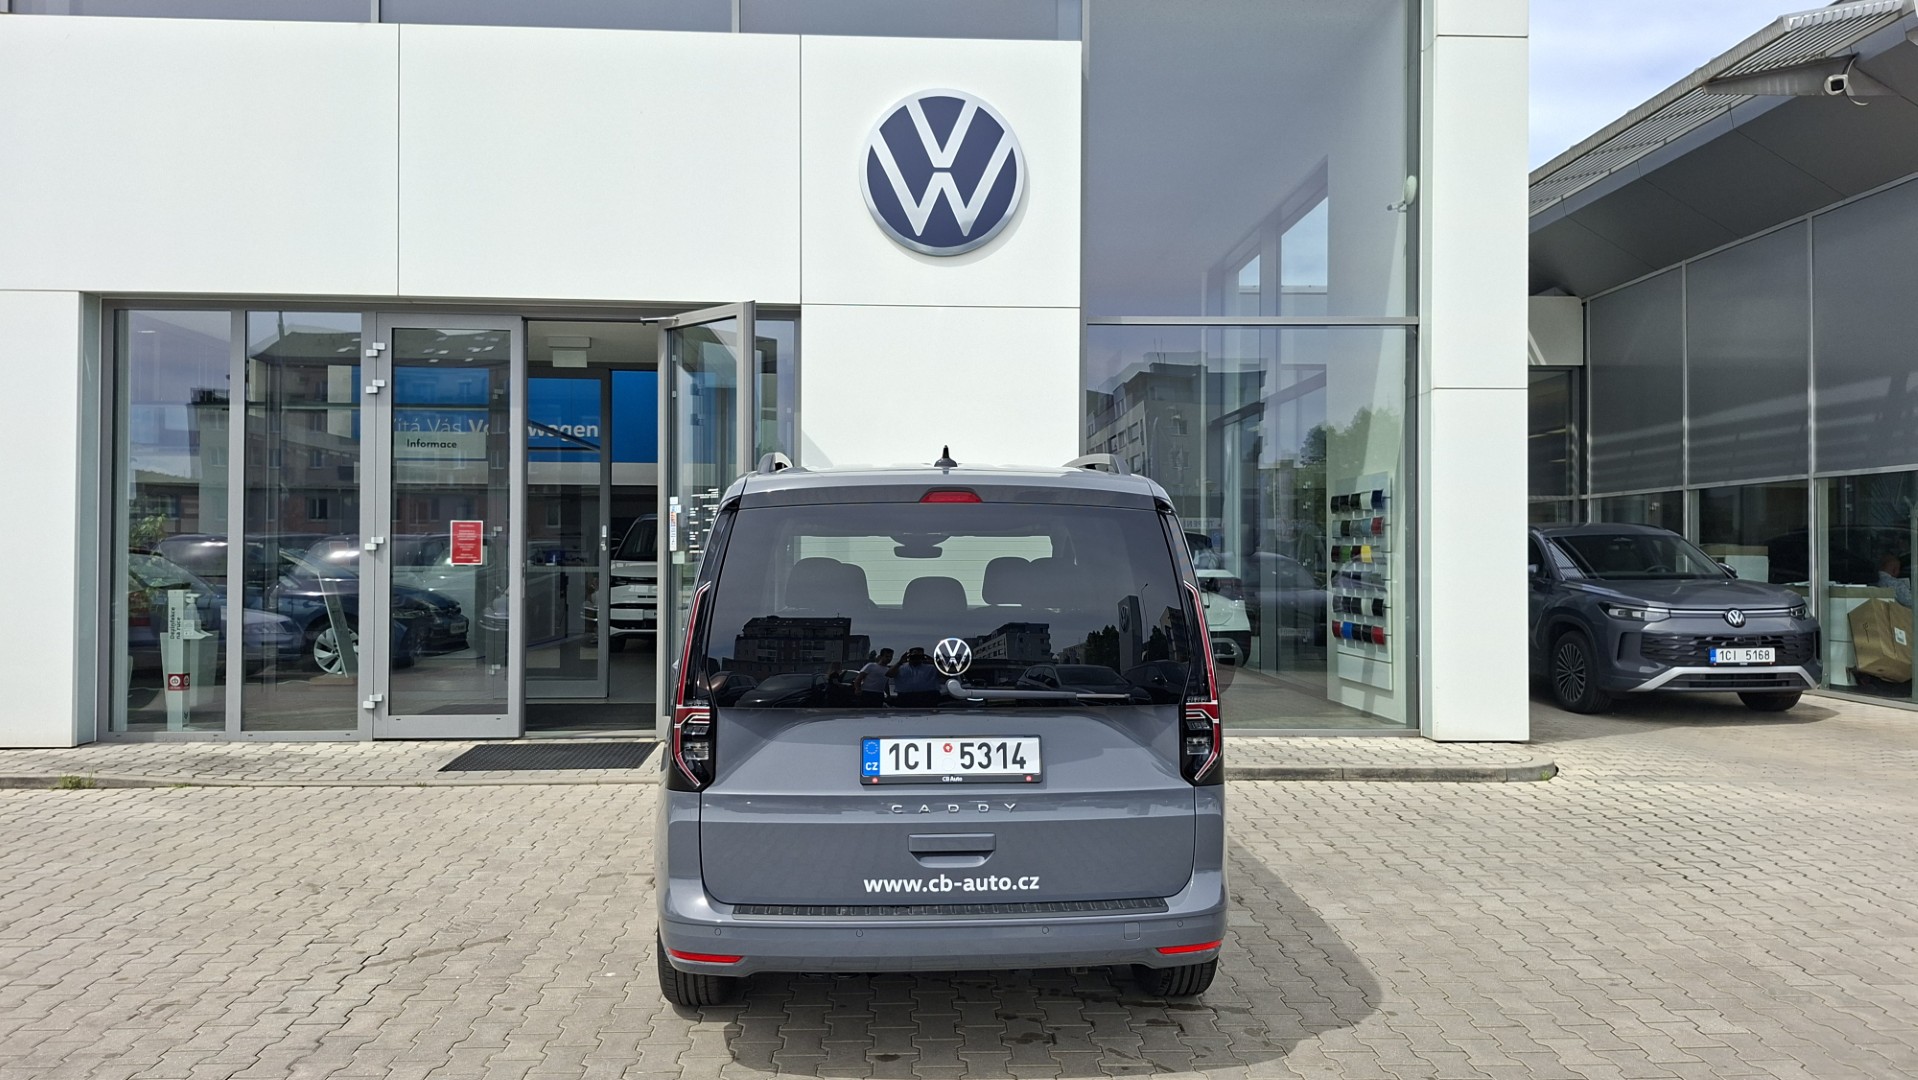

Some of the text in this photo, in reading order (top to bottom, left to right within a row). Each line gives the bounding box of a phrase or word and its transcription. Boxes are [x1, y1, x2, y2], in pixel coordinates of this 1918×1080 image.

[860, 90, 1022, 246] VW
[406, 438, 458, 449] Informace
[934, 637, 972, 676] VW
[1719, 650, 1737, 661] 1CI
[1745, 649, 1770, 661] 5168
[888, 741, 1027, 771] 1CI 5314
[865, 762, 879, 771] CZ
[891, 803, 1016, 815] CADDY
[863, 873, 1041, 893] www.cb-auto.cz
